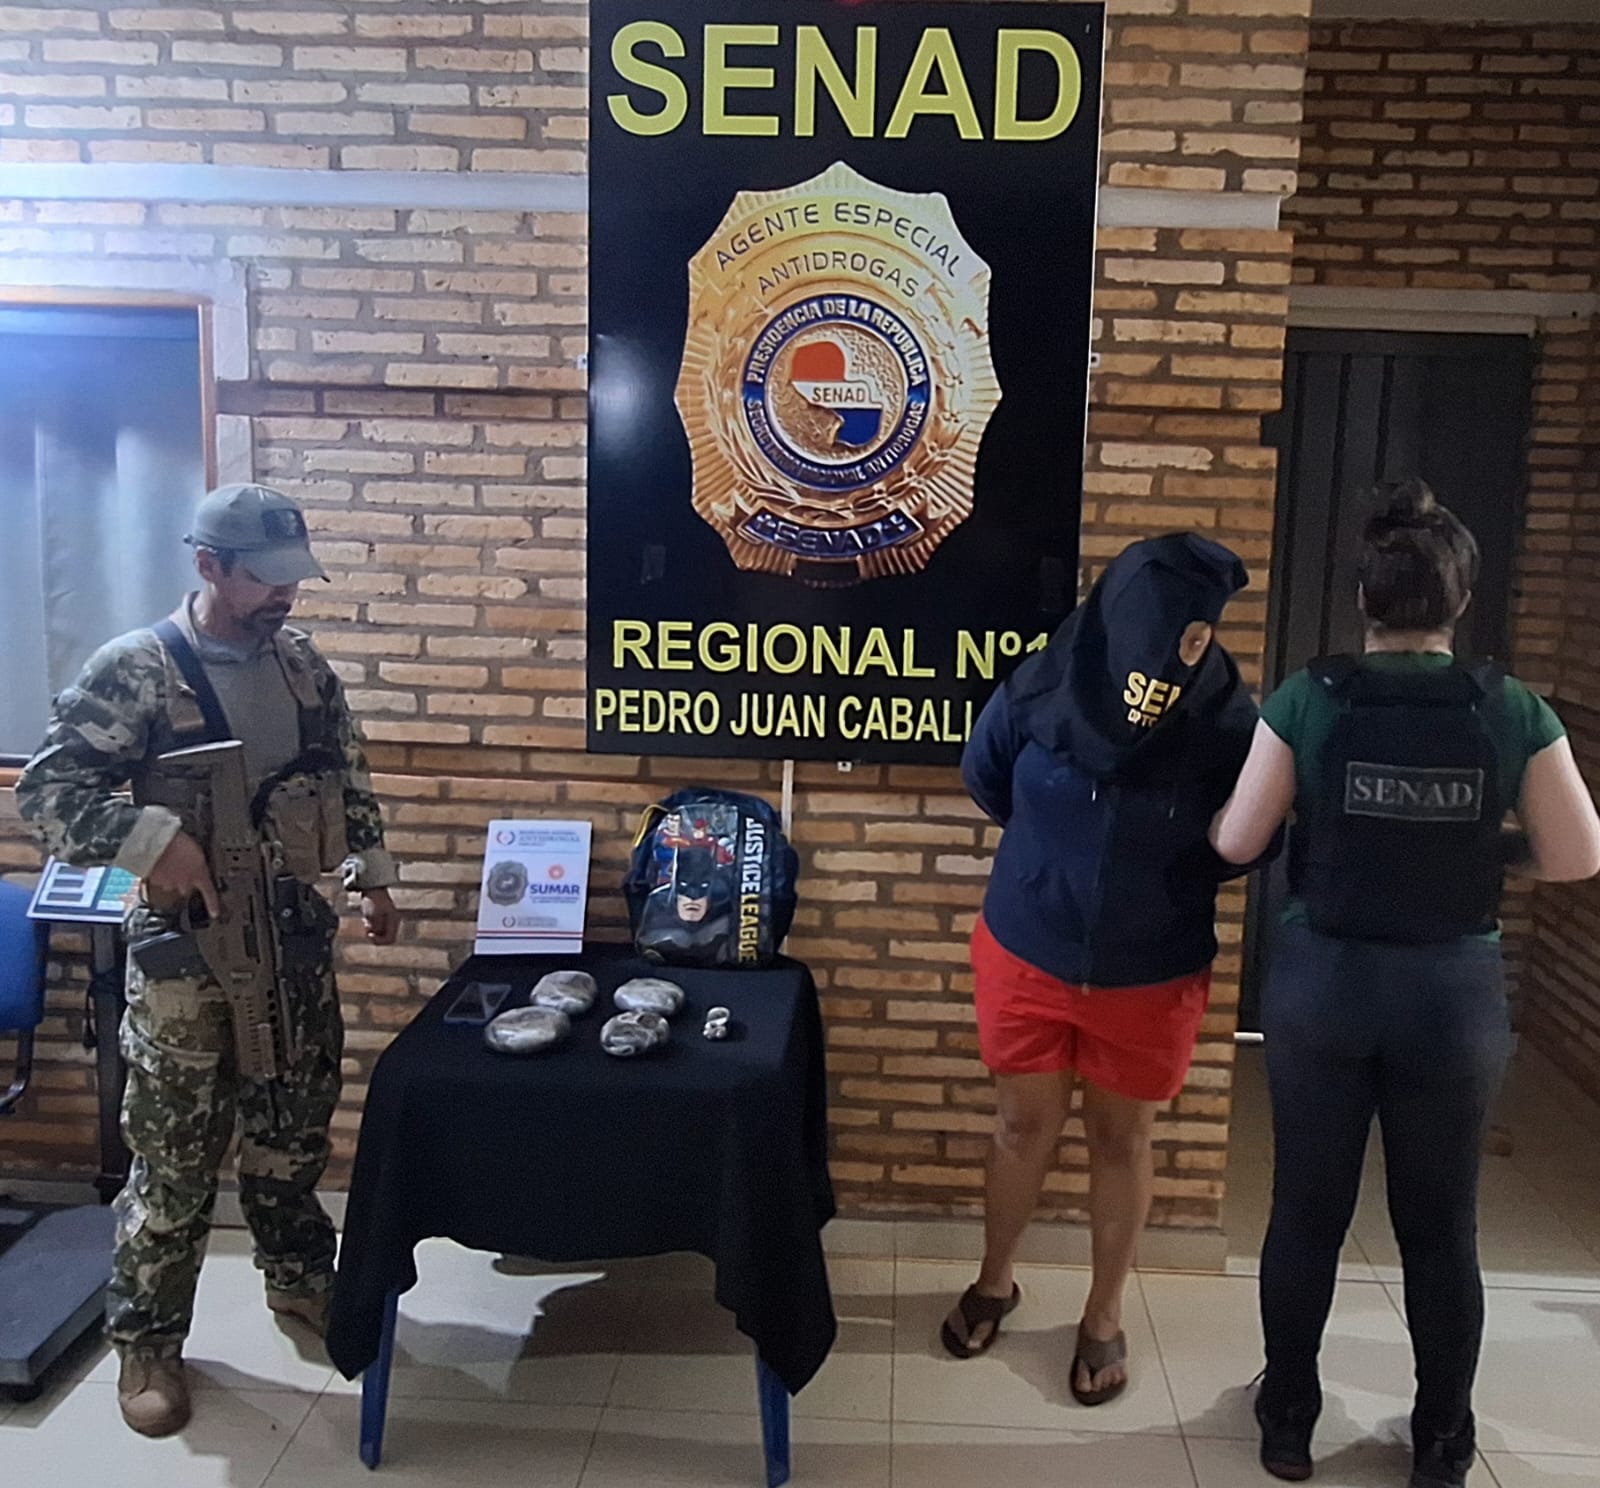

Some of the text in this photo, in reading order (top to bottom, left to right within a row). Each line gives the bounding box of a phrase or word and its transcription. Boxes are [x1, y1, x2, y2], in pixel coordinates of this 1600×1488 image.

[606, 21, 1082, 141] SENAD
[716, 202, 961, 278] AGENTE ESPECIAL
[758, 251, 920, 298] ANTIDROGAS
[746, 304, 823, 384] PRESIDENCIA
[823, 299, 846, 316] DE
[849, 299, 871, 320] LA
[812, 386, 866, 403] SENAD
[612, 619, 936, 678] REGIONAL
[595, 688, 720, 735] PEDRO
[730, 693, 826, 738] JUAN
[1352, 775, 1474, 808] SENAD
[530, 884, 580, 895] SUMAR
[738, 817, 764, 963] JUSTICE LEAGUE
